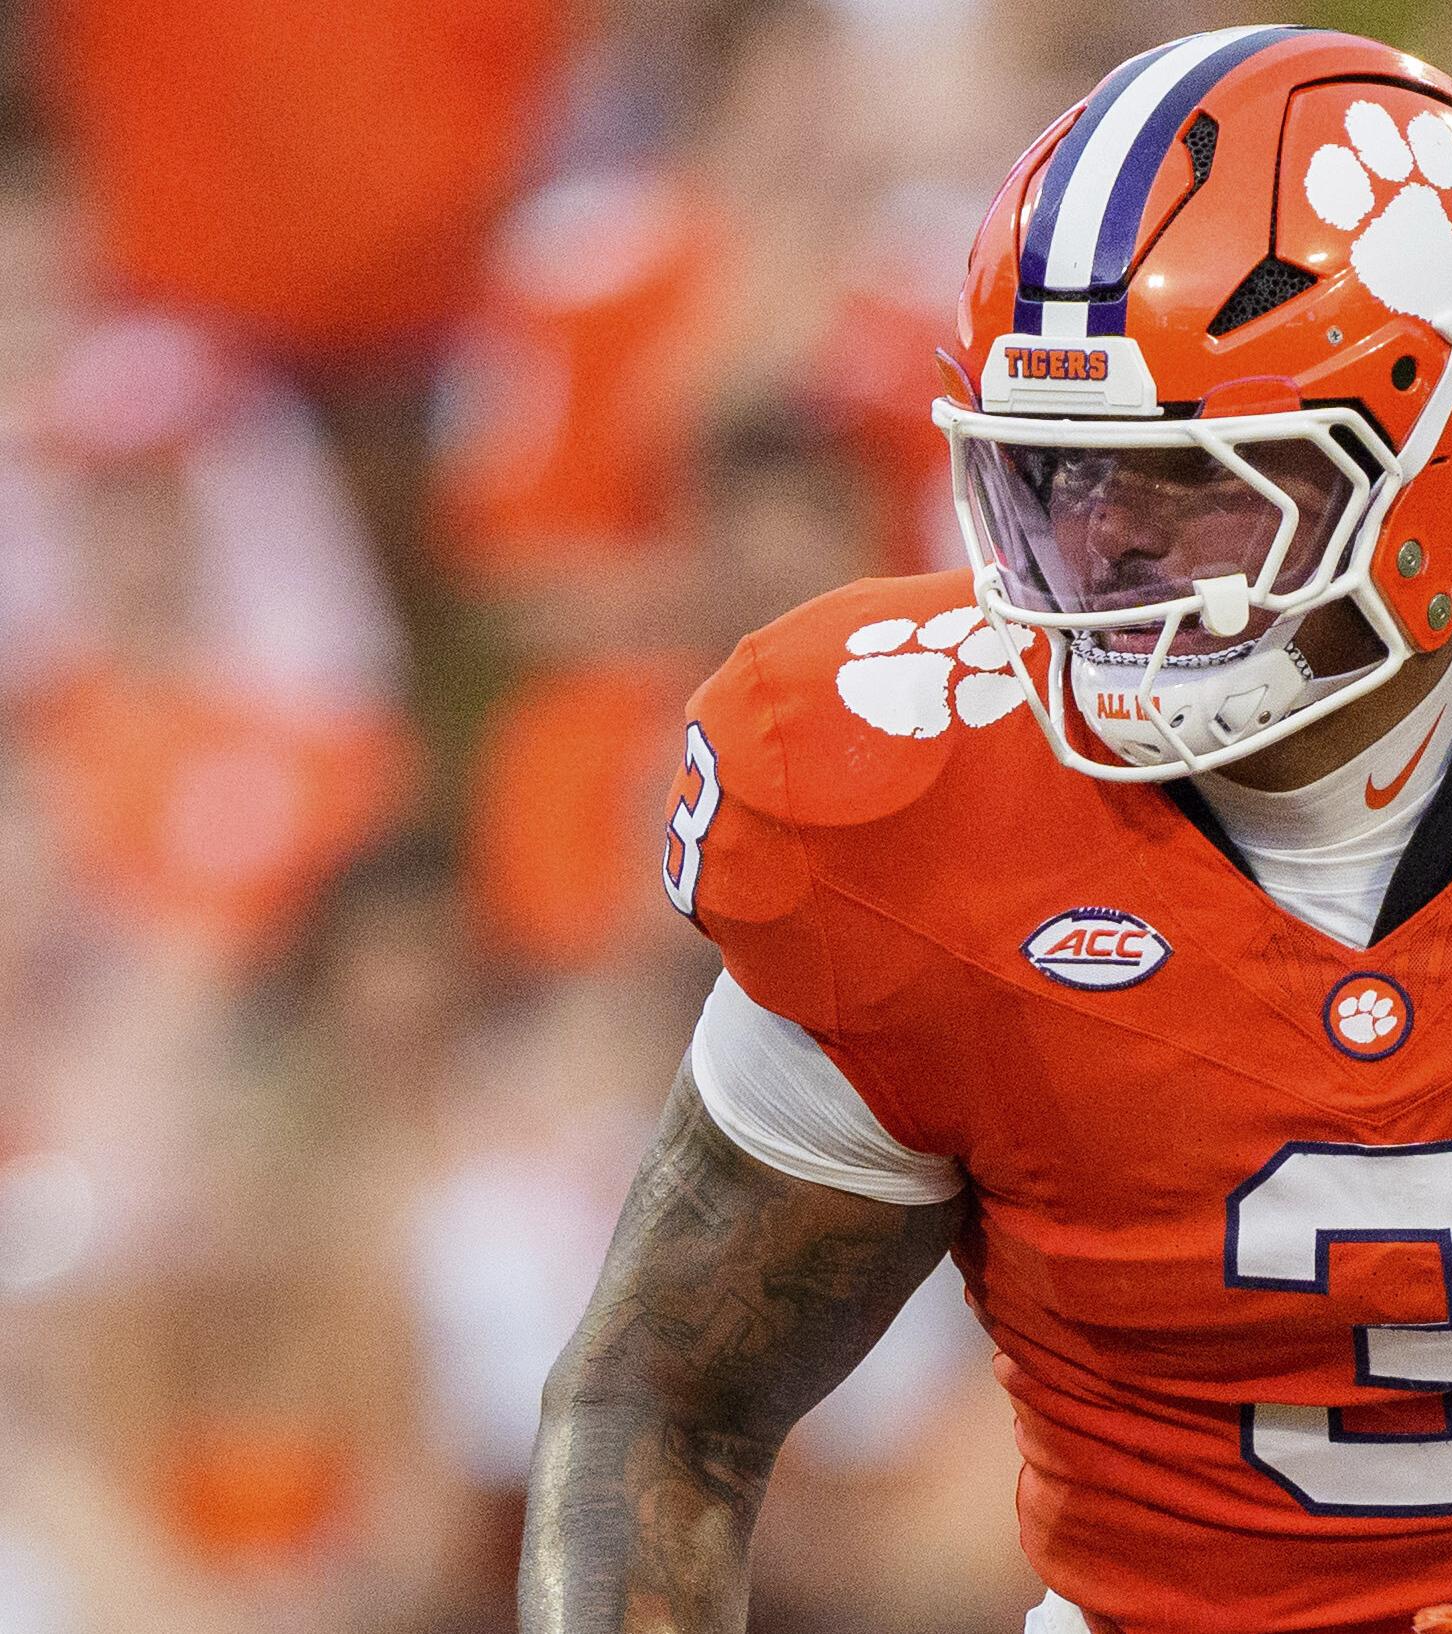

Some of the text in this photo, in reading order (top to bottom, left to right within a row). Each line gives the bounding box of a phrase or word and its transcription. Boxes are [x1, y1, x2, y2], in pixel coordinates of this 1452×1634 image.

[1004, 347, 1109, 381] TIGERS
[1097, 692, 1130, 720] ALL
[662, 720, 724, 918] 3
[1044, 929, 1151, 958] ACC
